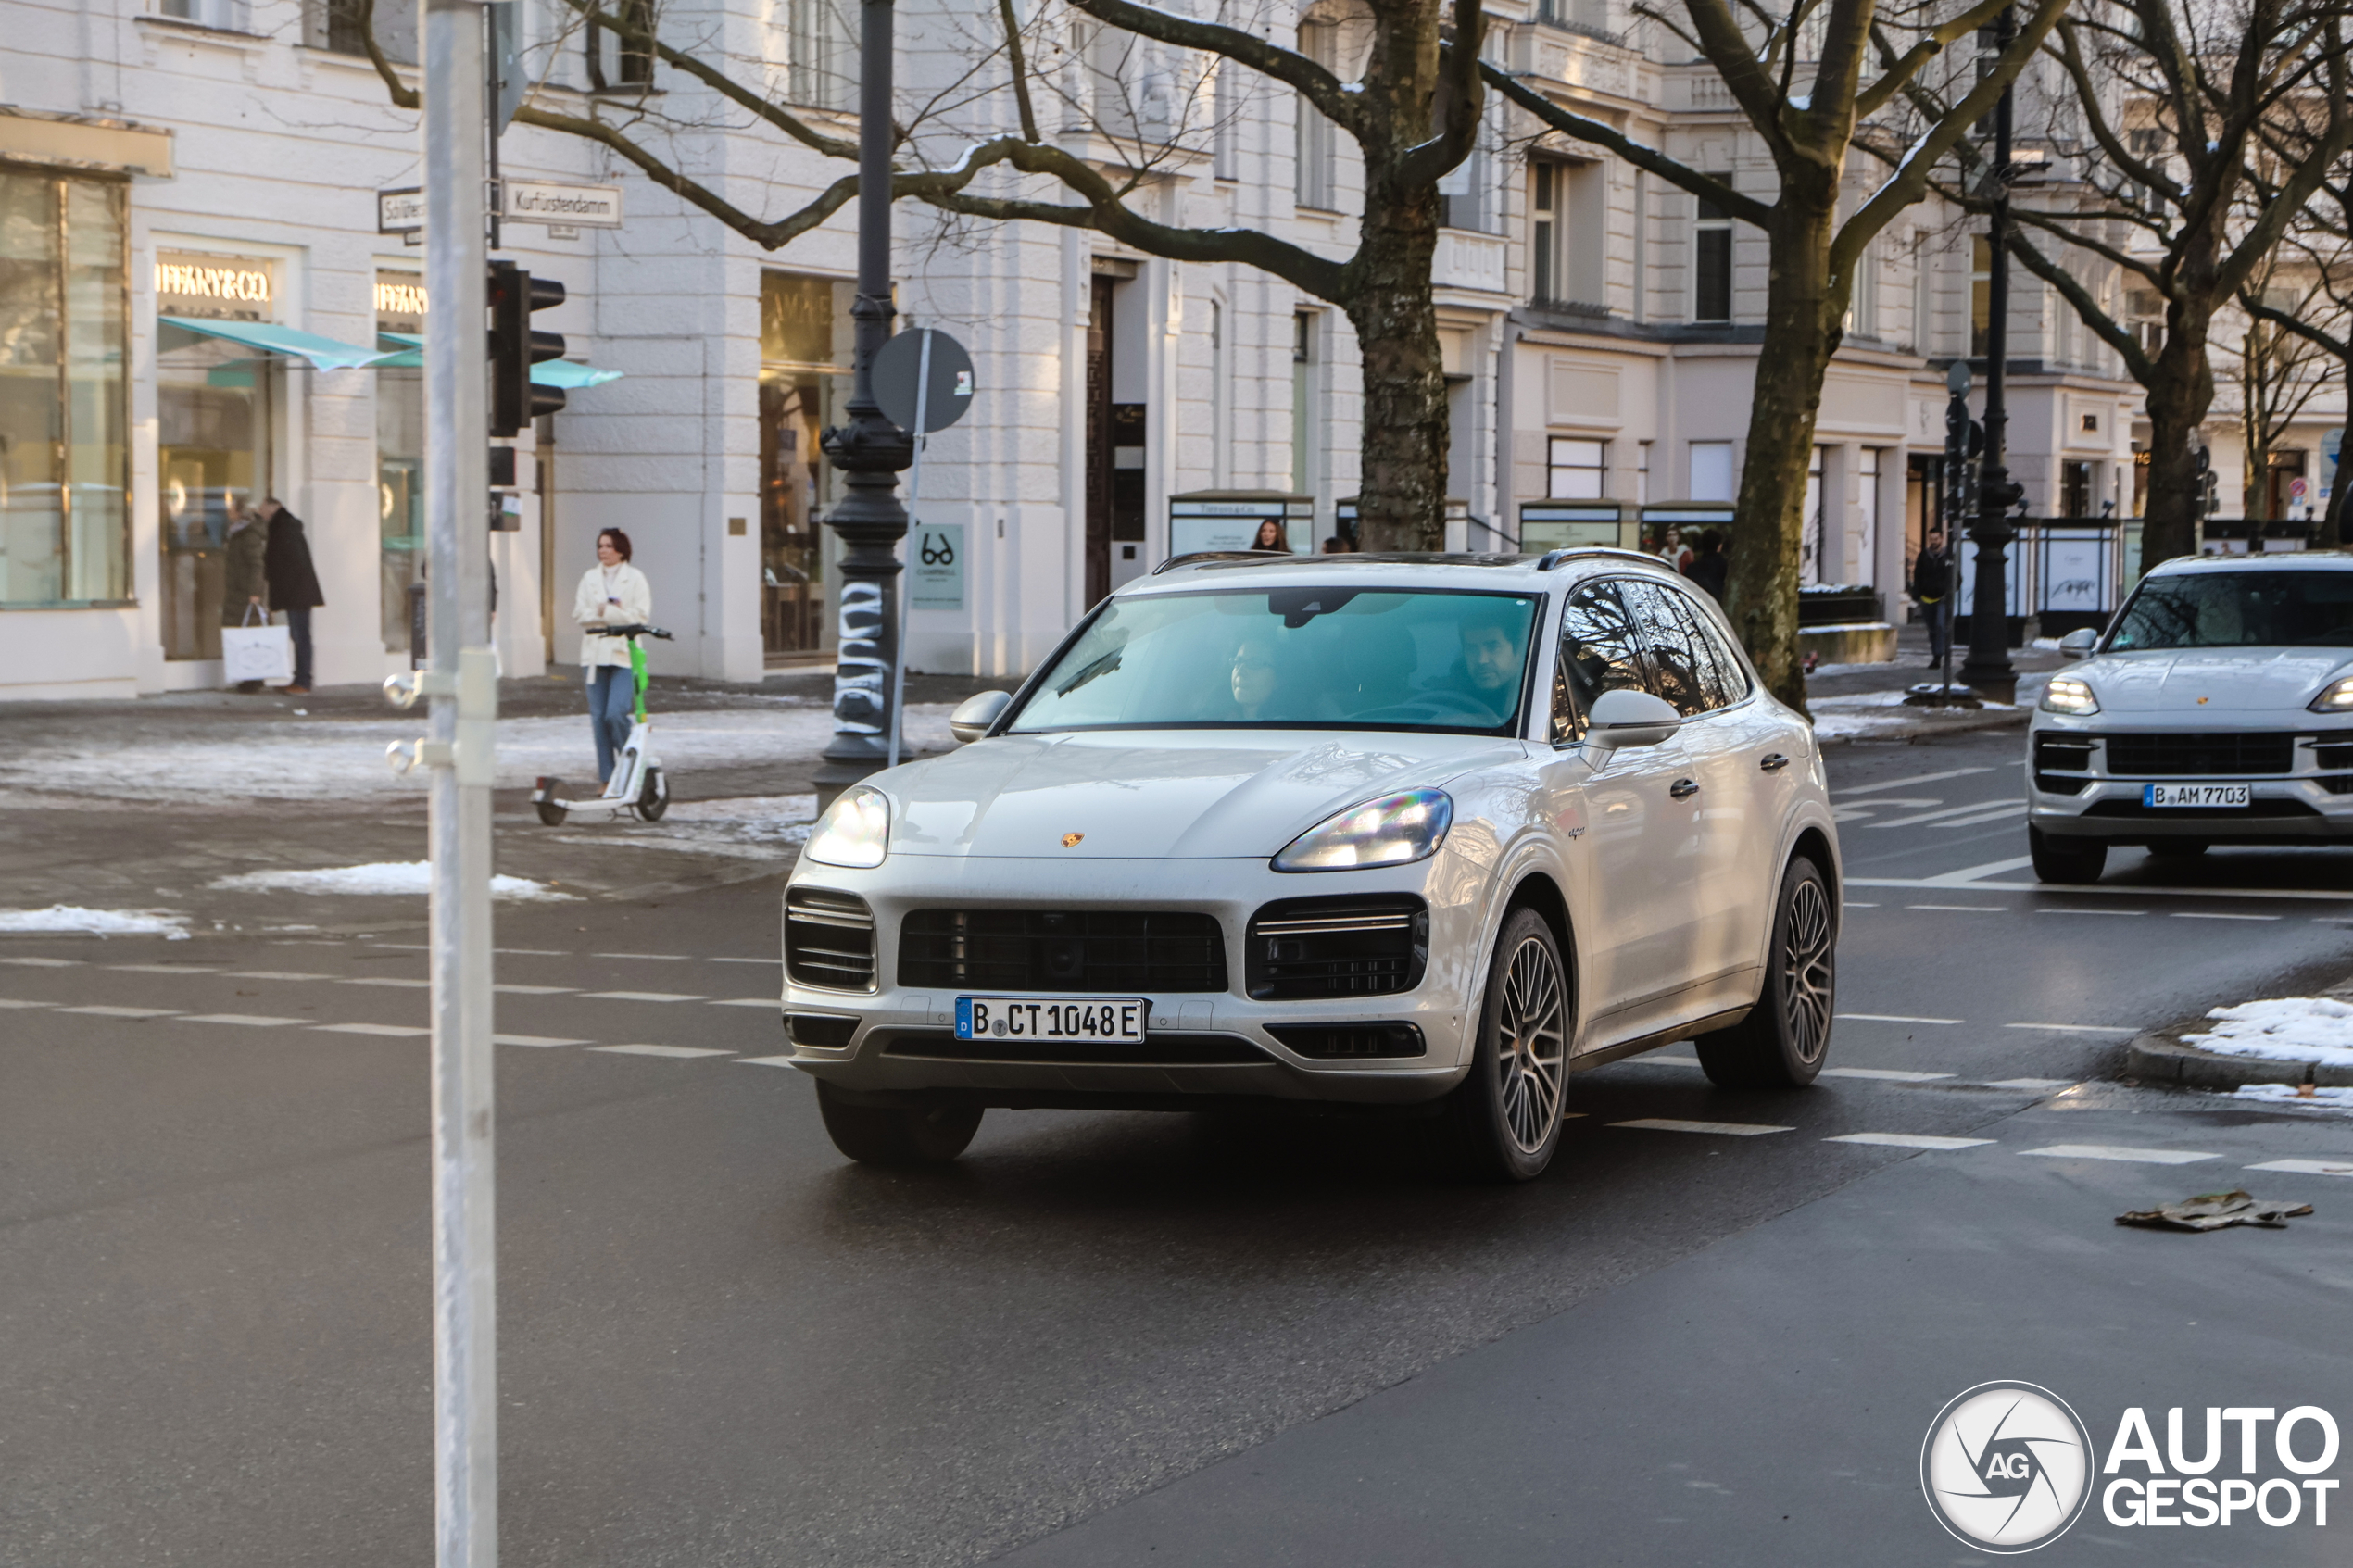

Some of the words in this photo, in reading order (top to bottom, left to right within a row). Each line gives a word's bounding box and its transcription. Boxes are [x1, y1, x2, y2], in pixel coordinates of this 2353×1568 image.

[515, 191, 610, 215] Kurfürstendamm
[2155, 787, 2166, 804] B
[973, 1003, 989, 1034] B
